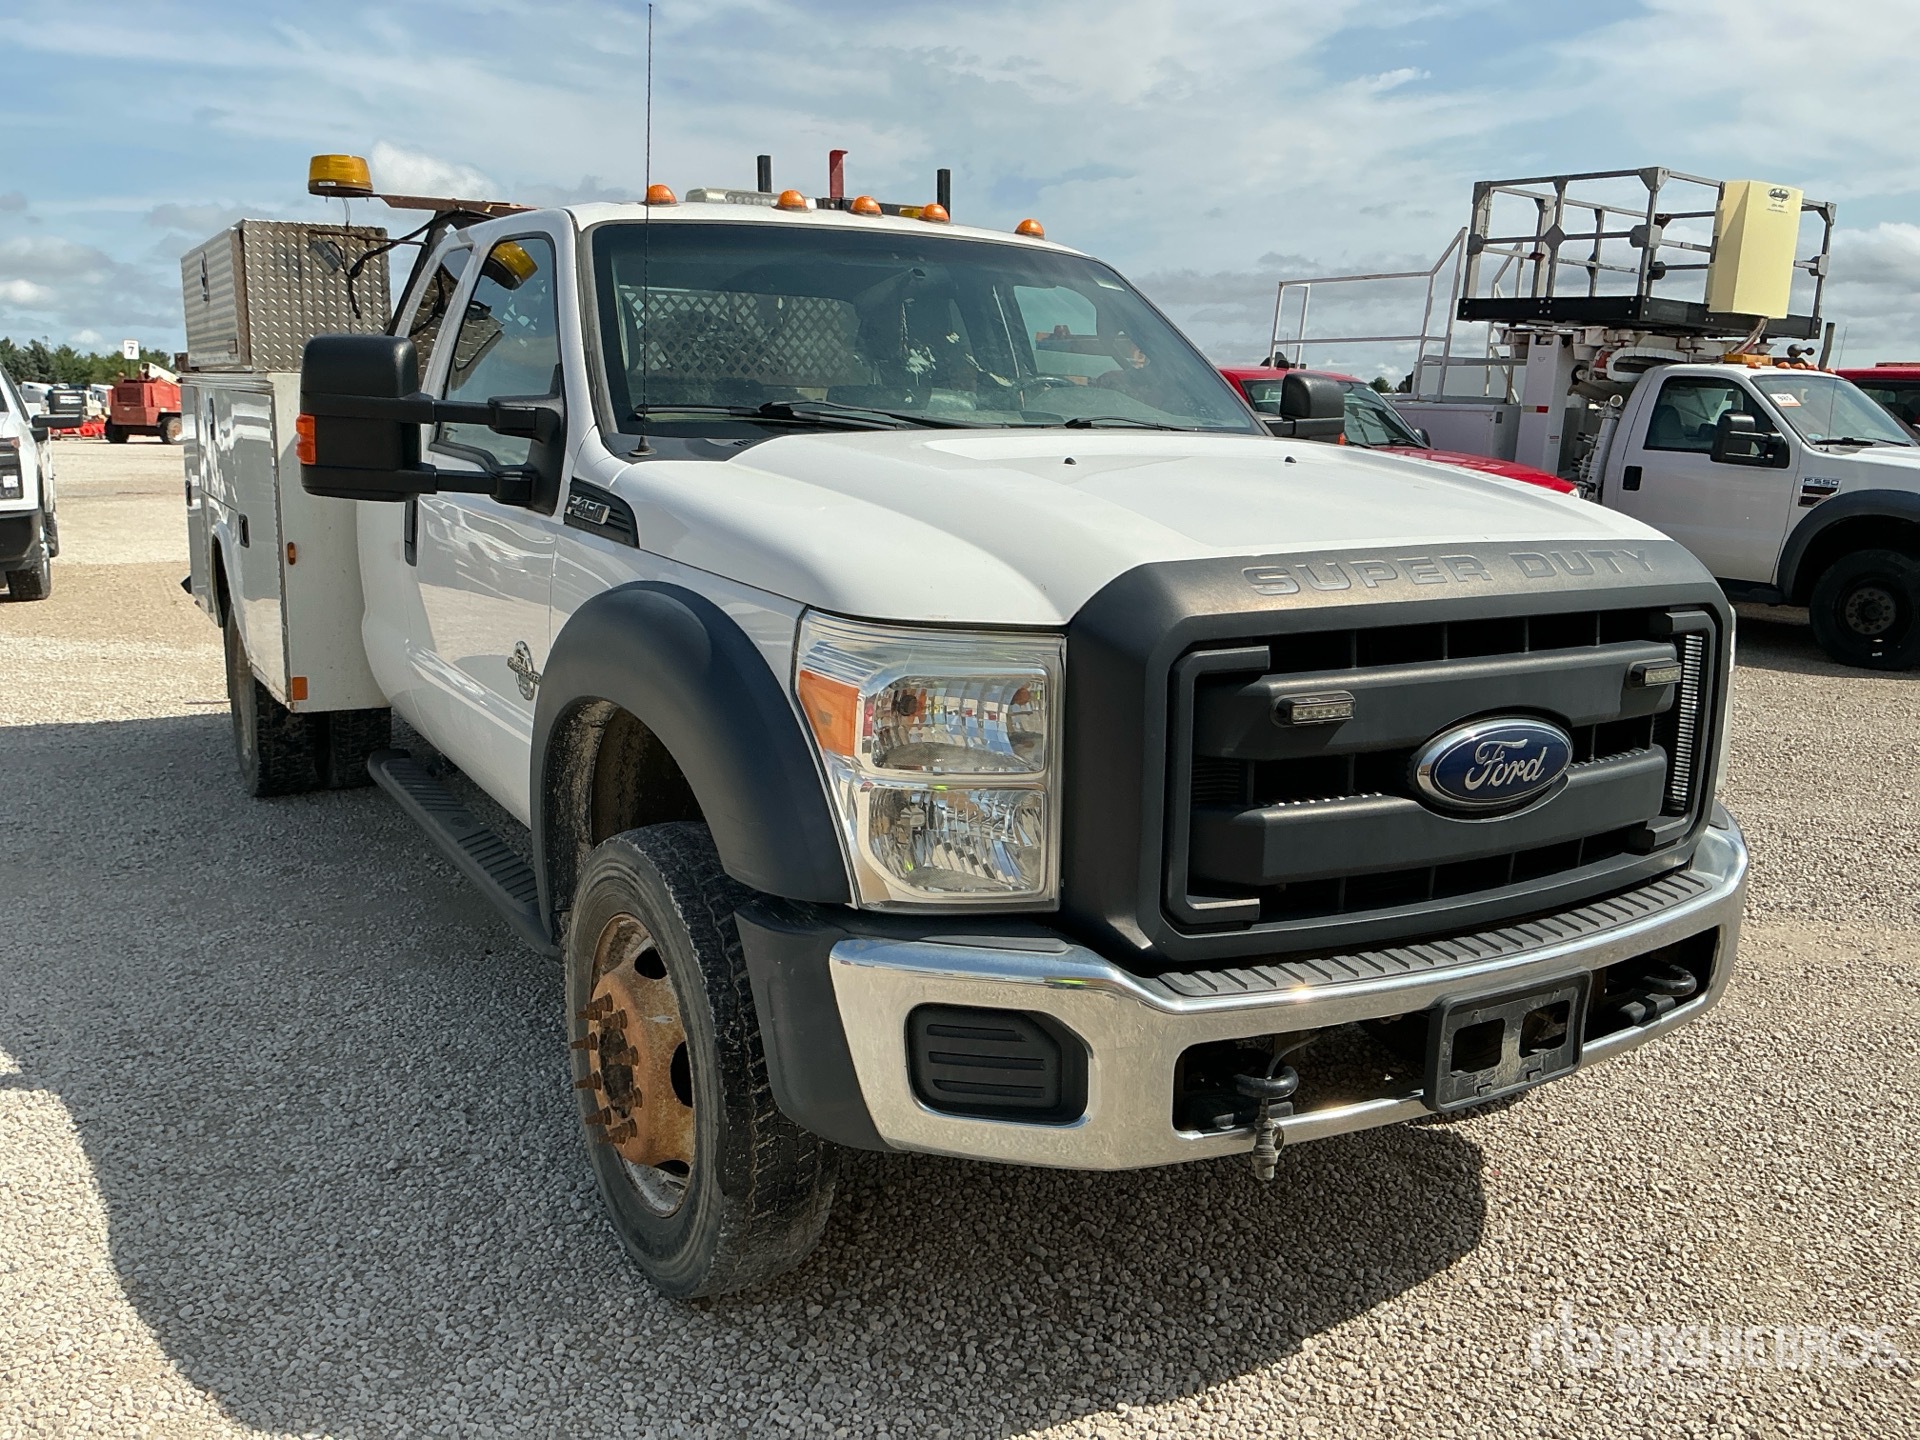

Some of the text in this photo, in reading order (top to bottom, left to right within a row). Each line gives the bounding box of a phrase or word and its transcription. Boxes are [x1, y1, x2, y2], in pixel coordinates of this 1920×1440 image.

[128, 346, 135, 355] 7
[1242, 549, 1654, 596] SUPER DUTY
[1464, 738, 1548, 791] Ford
